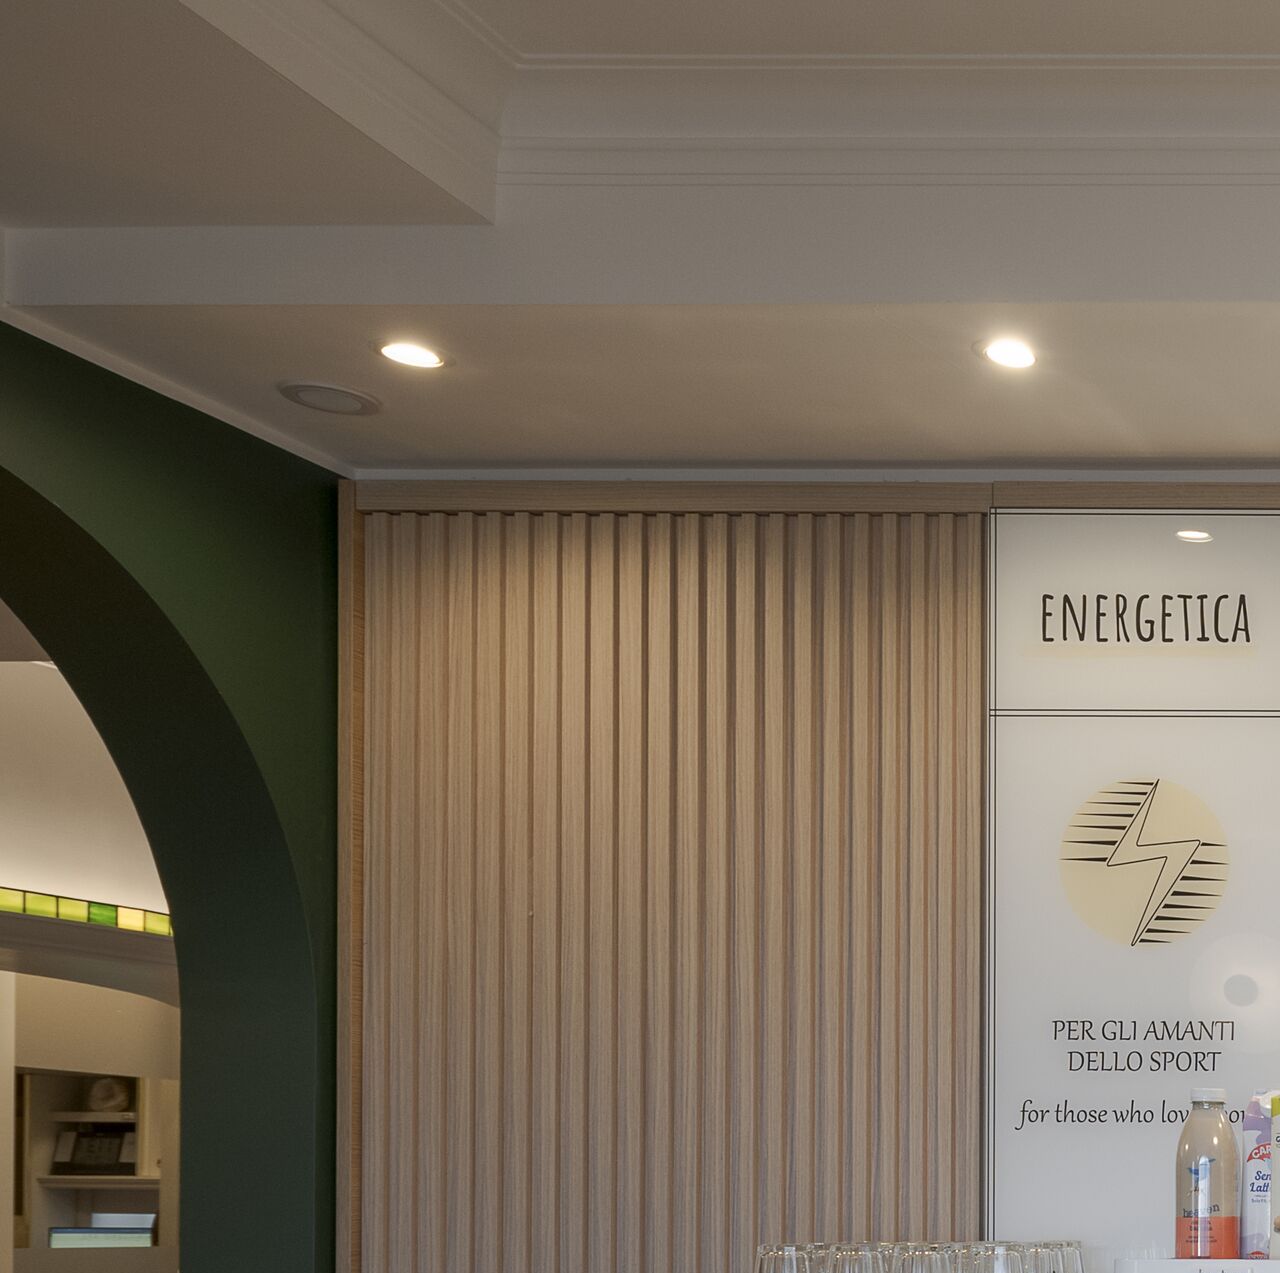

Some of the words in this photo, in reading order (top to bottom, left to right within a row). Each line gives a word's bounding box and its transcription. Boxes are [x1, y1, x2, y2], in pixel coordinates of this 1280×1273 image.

[1041, 594, 1251, 643] ENERGETICA
[1052, 1020, 1095, 1041] PER
[1101, 1020, 1137, 1041] GLI
[1144, 1020, 1235, 1041] AMANTI
[1067, 1051, 1143, 1072] DELLO
[1149, 1051, 1222, 1072] SPORT
[1014, 1100, 1050, 1130] for
[1054, 1100, 1108, 1123] those
[1112, 1100, 1154, 1123] who
[1161, 1100, 1189, 1123] lov
